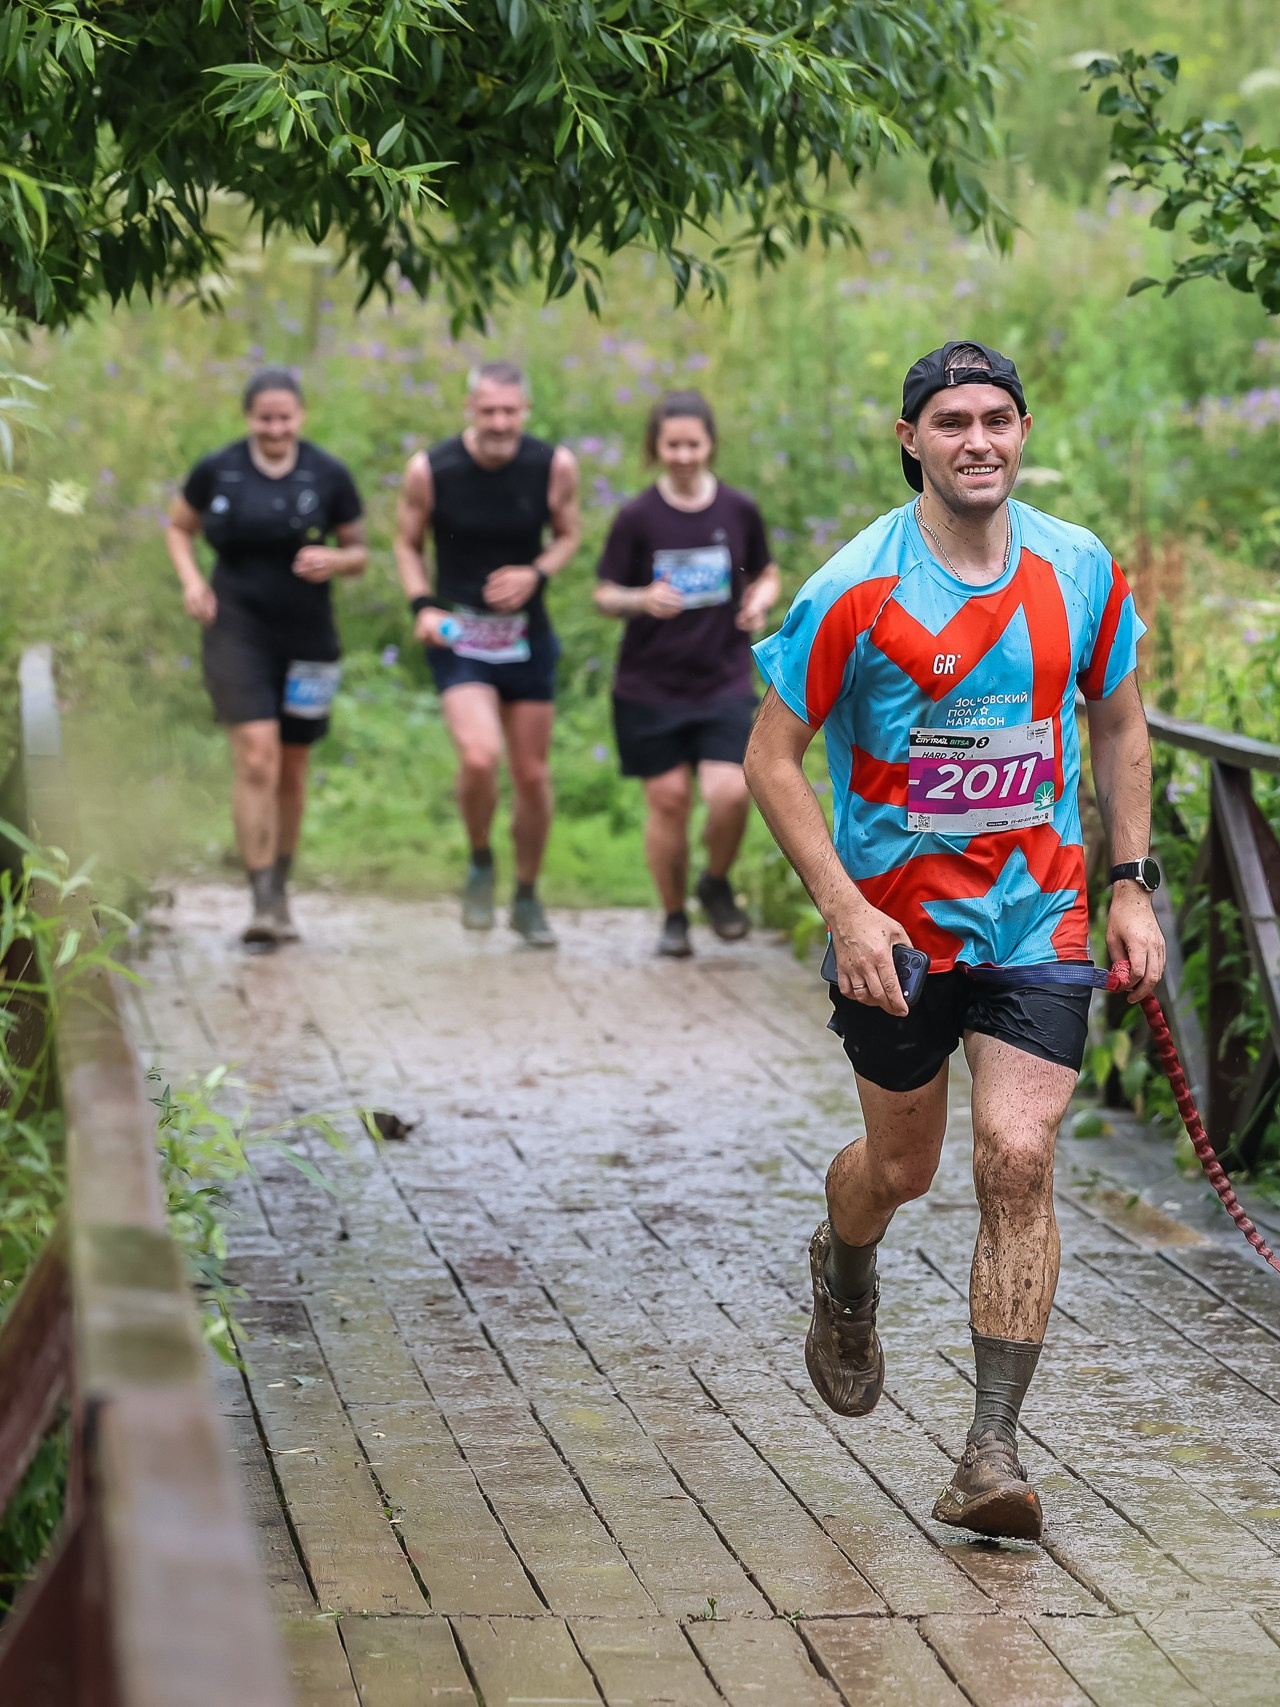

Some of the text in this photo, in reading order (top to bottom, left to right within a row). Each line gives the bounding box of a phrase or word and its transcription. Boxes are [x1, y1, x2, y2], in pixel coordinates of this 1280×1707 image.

[945, 716, 1005, 727] МАРАФОН
[979, 738, 987, 747] 3
[921, 751, 947, 759] HARD
[949, 751, 966, 760] 20
[925, 756, 1038, 801] 2011
